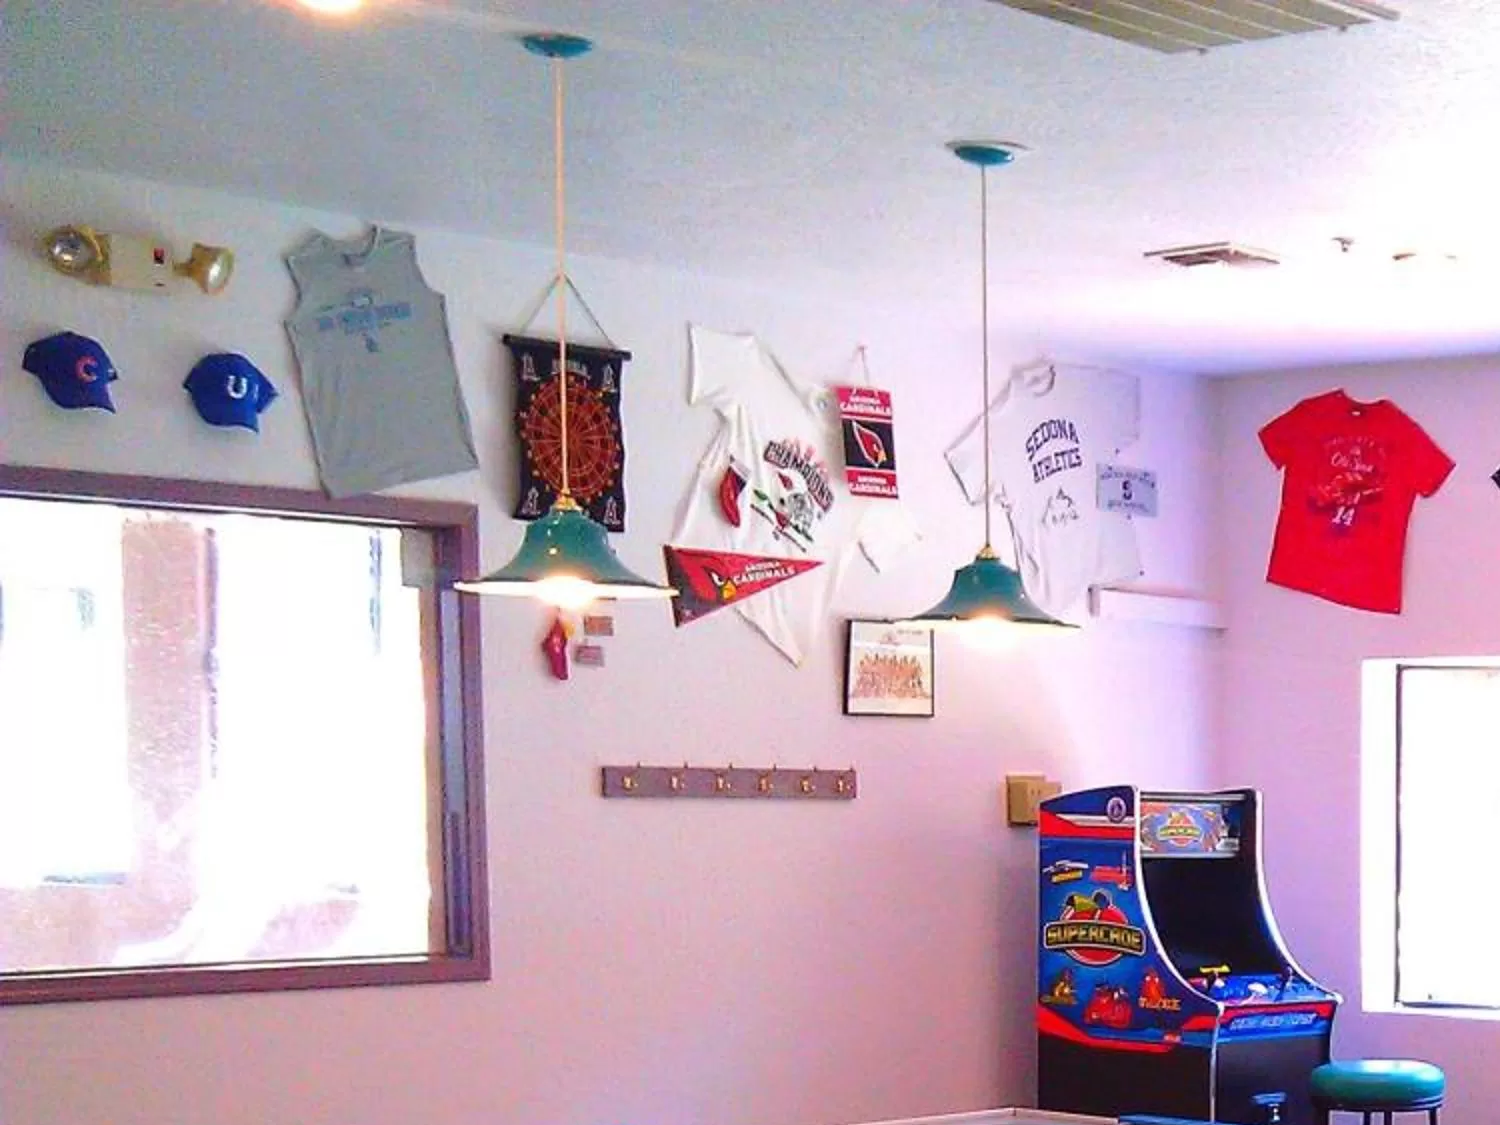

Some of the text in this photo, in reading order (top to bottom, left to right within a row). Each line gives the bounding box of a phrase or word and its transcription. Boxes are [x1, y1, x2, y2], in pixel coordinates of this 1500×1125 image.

[1025, 418, 1080, 462] SEDONA
[1331, 506, 1355, 527] 14
[1046, 924, 1142, 950] SUPERCADE
